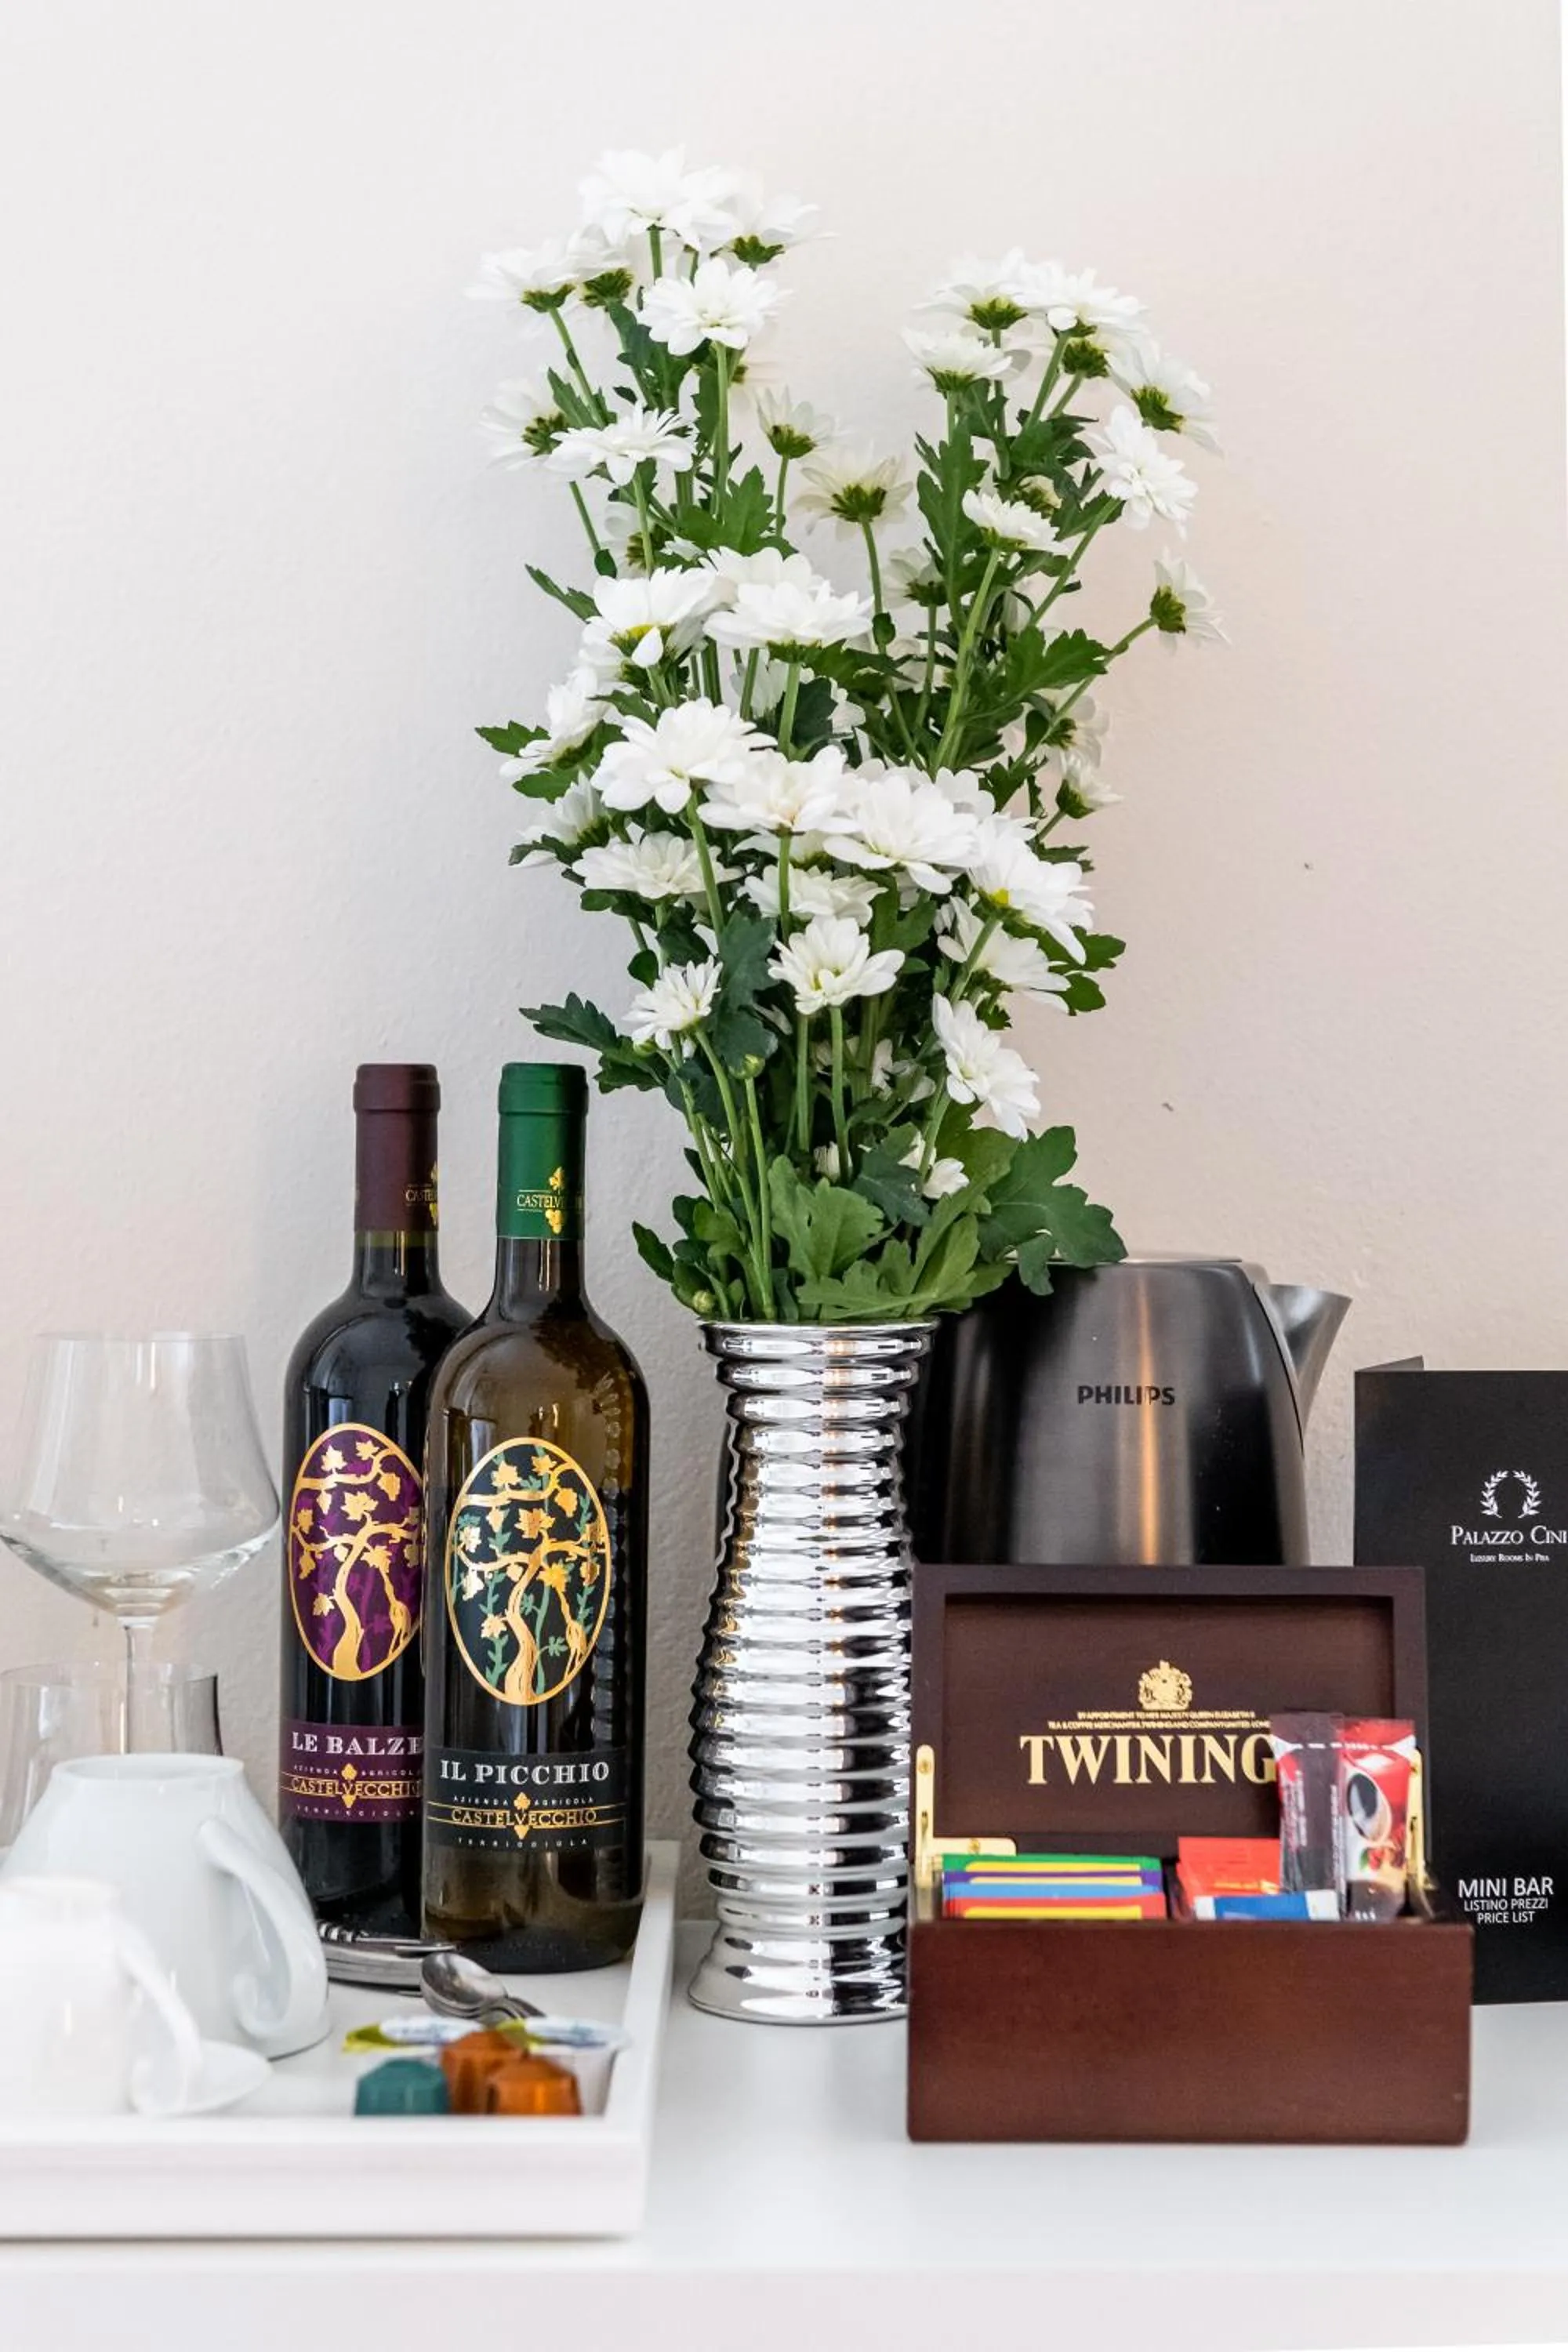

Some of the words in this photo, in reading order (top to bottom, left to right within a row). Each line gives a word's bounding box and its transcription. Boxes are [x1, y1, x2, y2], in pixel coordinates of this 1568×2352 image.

[1078, 1385, 1175, 1405] PHILIPS
[1450, 1525, 1524, 1545] PALAZZO
[1530, 1525, 1567, 1544] CINI
[292, 1732, 318, 1752] LE
[440, 1760, 466, 1780] IL
[474, 1762, 609, 1785] PICCHIO
[454, 1795, 509, 1806] AZIENDA
[534, 1796, 594, 1806] AGRICOLA
[451, 1808, 597, 1826] CASTELVECCHIO
[1458, 1878, 1507, 1897] MINI
[1514, 1876, 1554, 1896] BAR
[1464, 1899, 1508, 1911] LISTINO
[1511, 1897, 1549, 1910] PREZZI
[1477, 1912, 1510, 1924] PRICE
[1512, 1911, 1536, 1923] LIST
